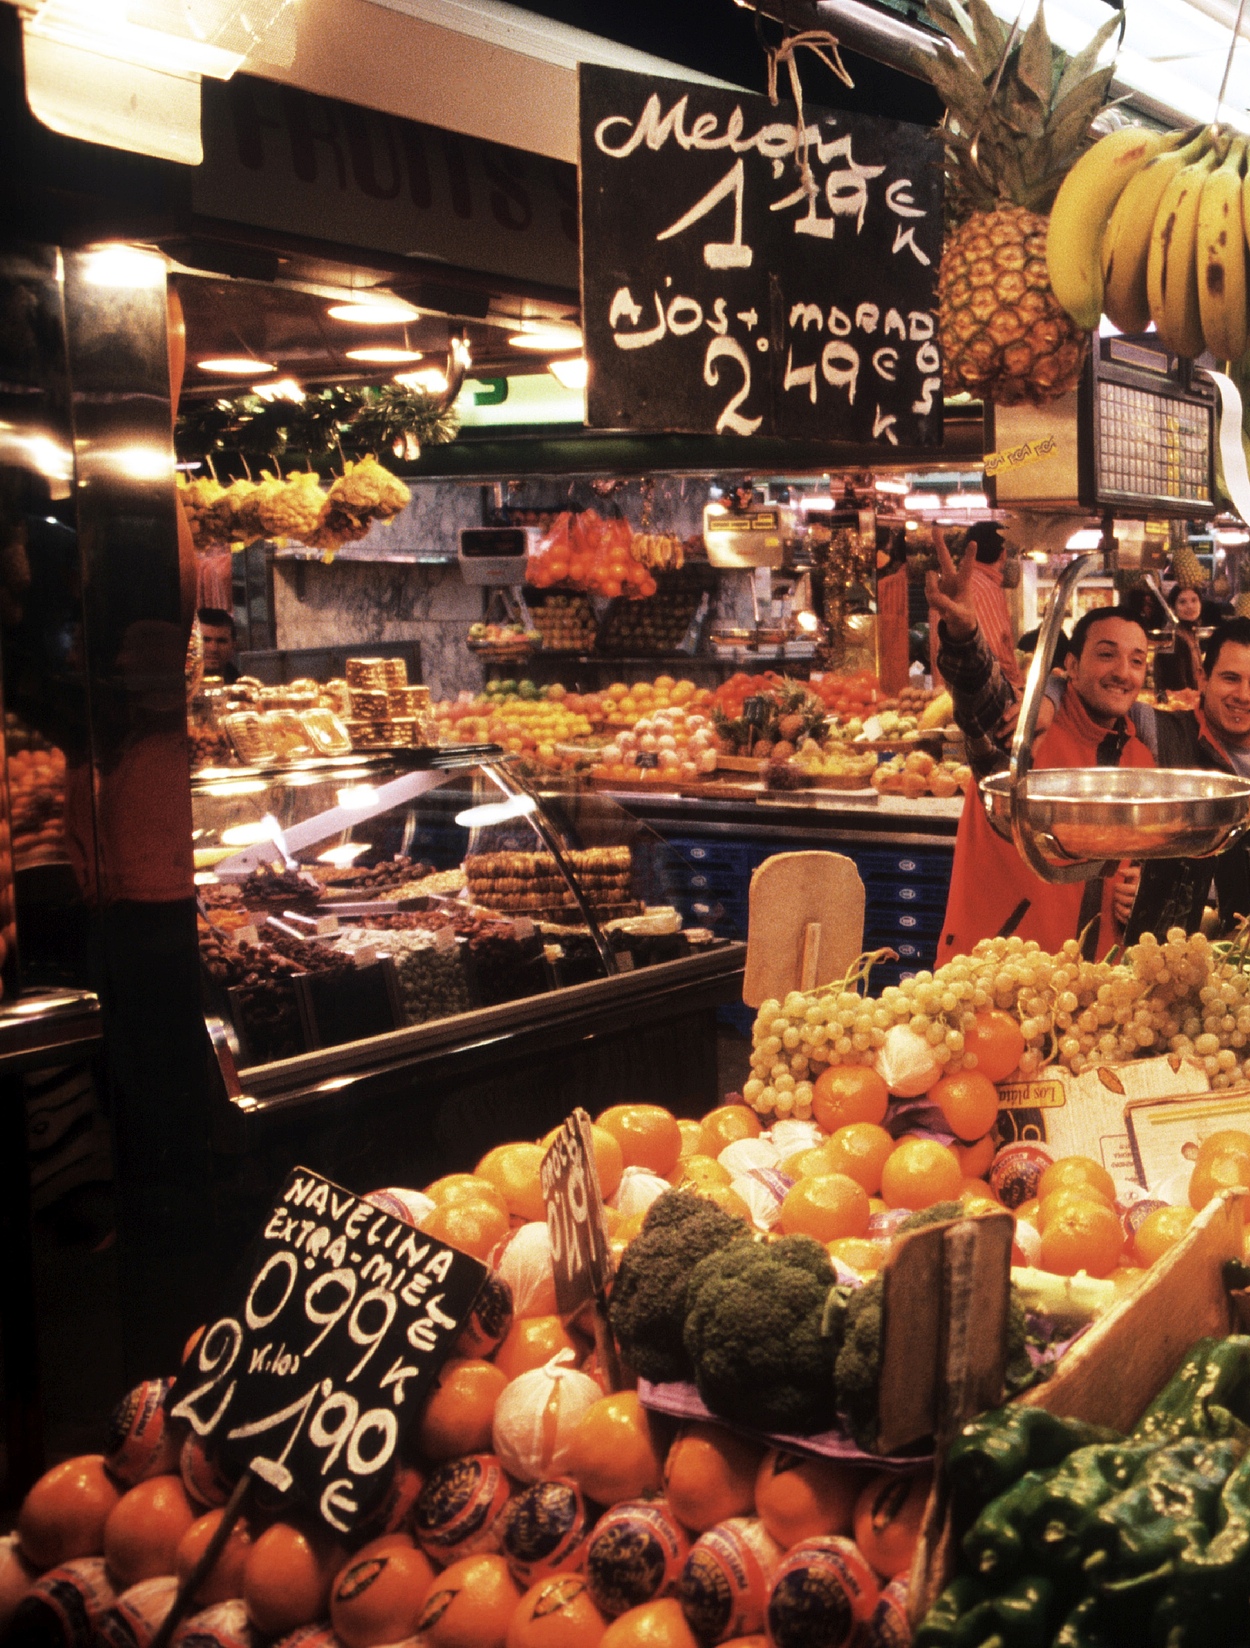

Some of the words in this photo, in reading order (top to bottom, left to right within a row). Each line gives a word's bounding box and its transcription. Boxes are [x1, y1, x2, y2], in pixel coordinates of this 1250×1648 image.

[998, 1084, 1030, 1106] pláta
[1034, 1086, 1056, 1103] Los
[284, 1177, 454, 1284] NAVELINA
